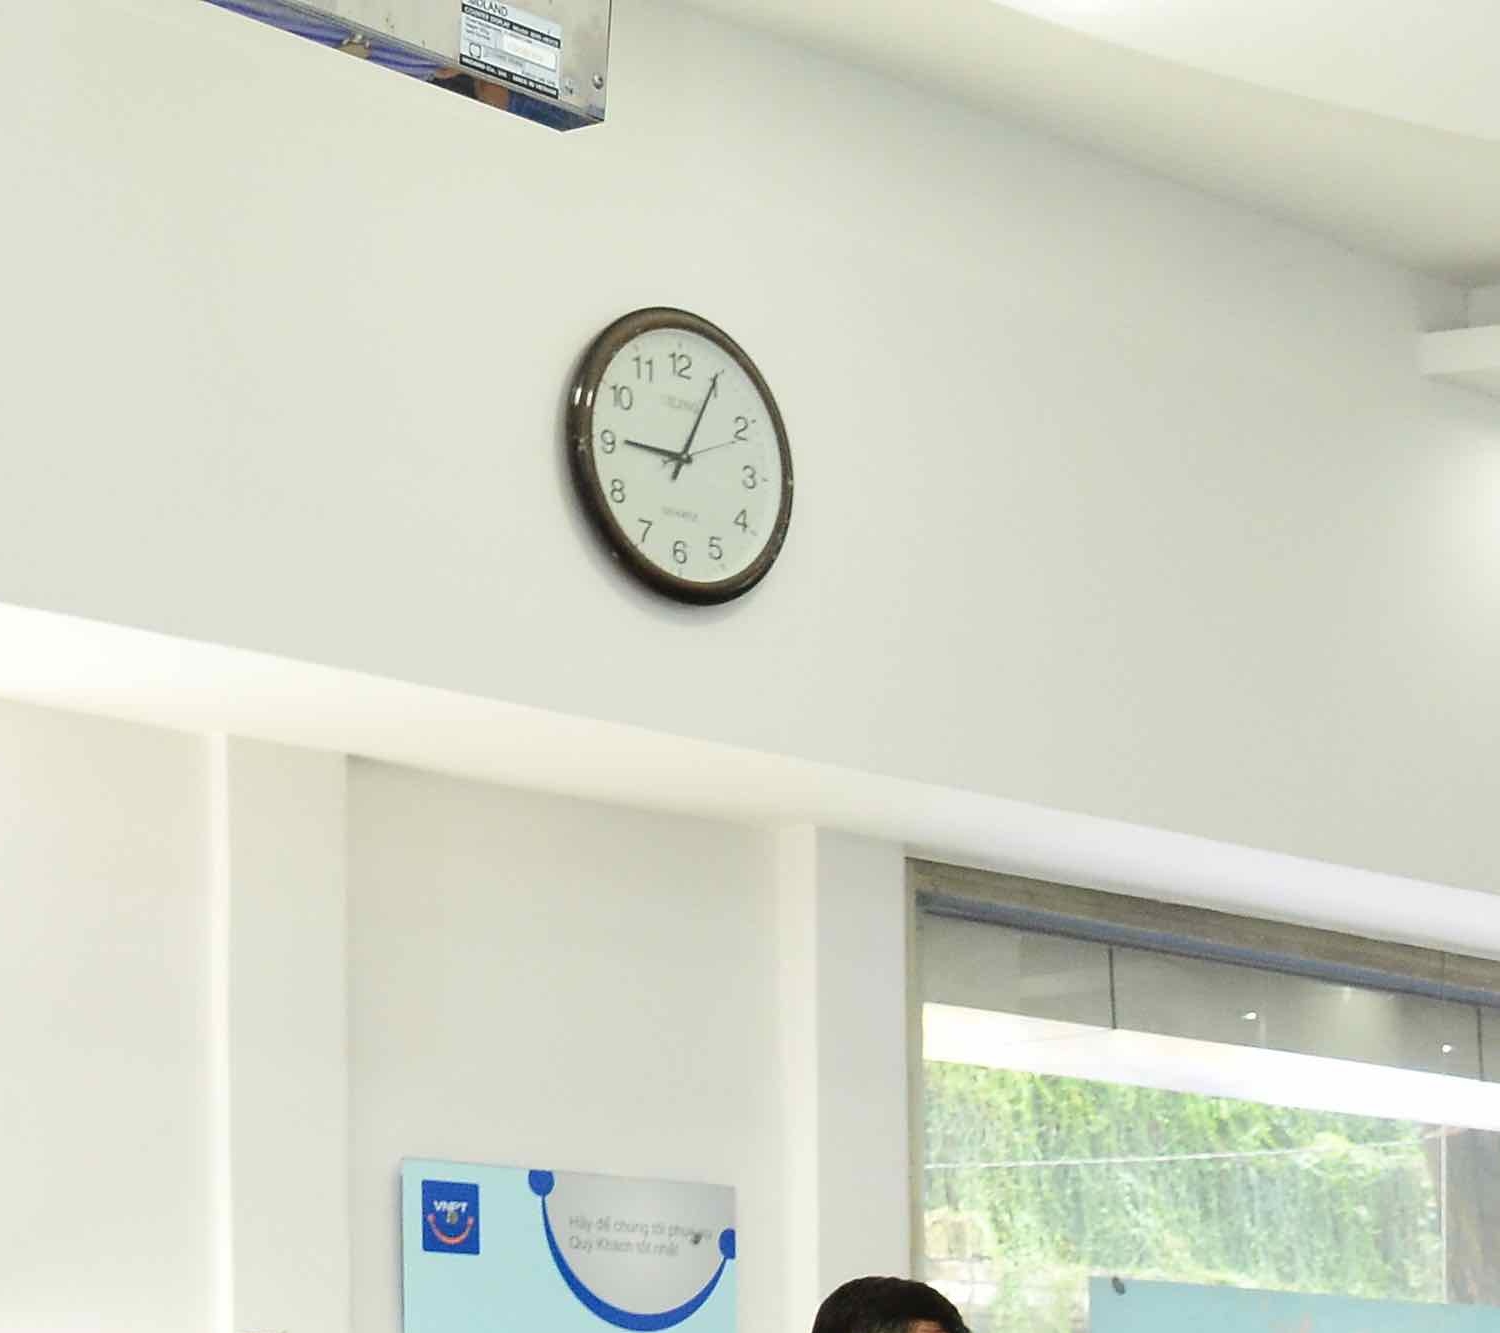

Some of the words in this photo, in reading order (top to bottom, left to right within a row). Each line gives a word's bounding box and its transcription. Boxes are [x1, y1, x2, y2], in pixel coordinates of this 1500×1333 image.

[632, 356, 653, 382] 11
[669, 353, 692, 380] 12
[611, 384, 633, 411] 10
[734, 416, 749, 441] 2
[600, 430, 616, 454] 9
[742, 465, 757, 489] 3
[610, 479, 626, 503] 8
[637, 517, 653, 543] 7
[734, 509, 749, 532] 4
[672, 540, 688, 564] 6
[708, 536, 723, 560] 5
[433, 1200, 468, 1213] VNPT
